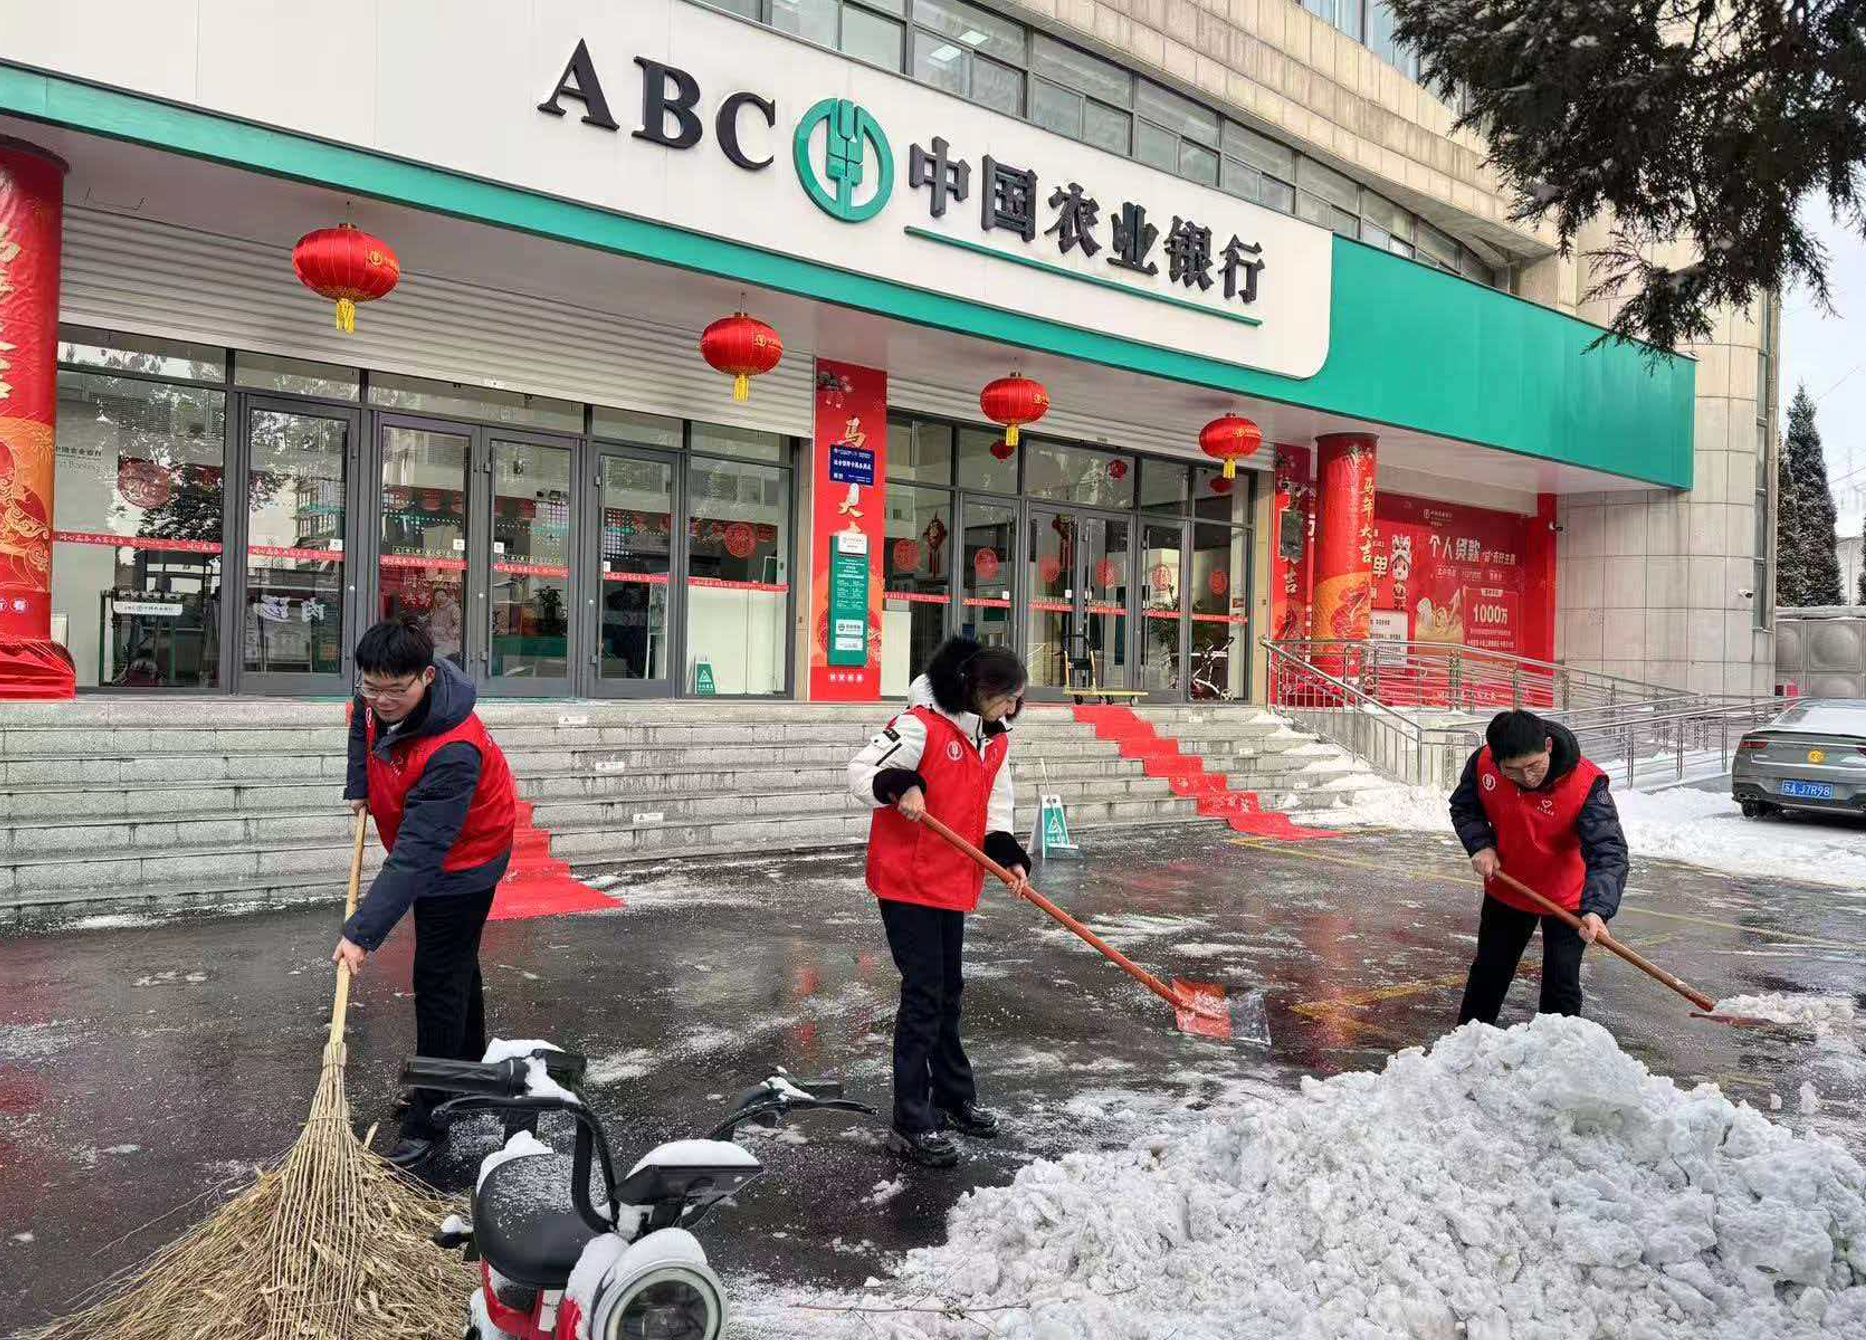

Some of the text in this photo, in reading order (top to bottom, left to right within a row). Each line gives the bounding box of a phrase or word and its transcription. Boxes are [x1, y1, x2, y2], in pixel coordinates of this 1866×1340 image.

[537, 38, 776, 171] ABC
[909, 136, 1266, 304] 中国农业银行
[1358, 477, 1374, 563] 马年大吉
[1428, 534, 1481, 562] 个人贷款
[1473, 602, 1509, 624] 1000万
